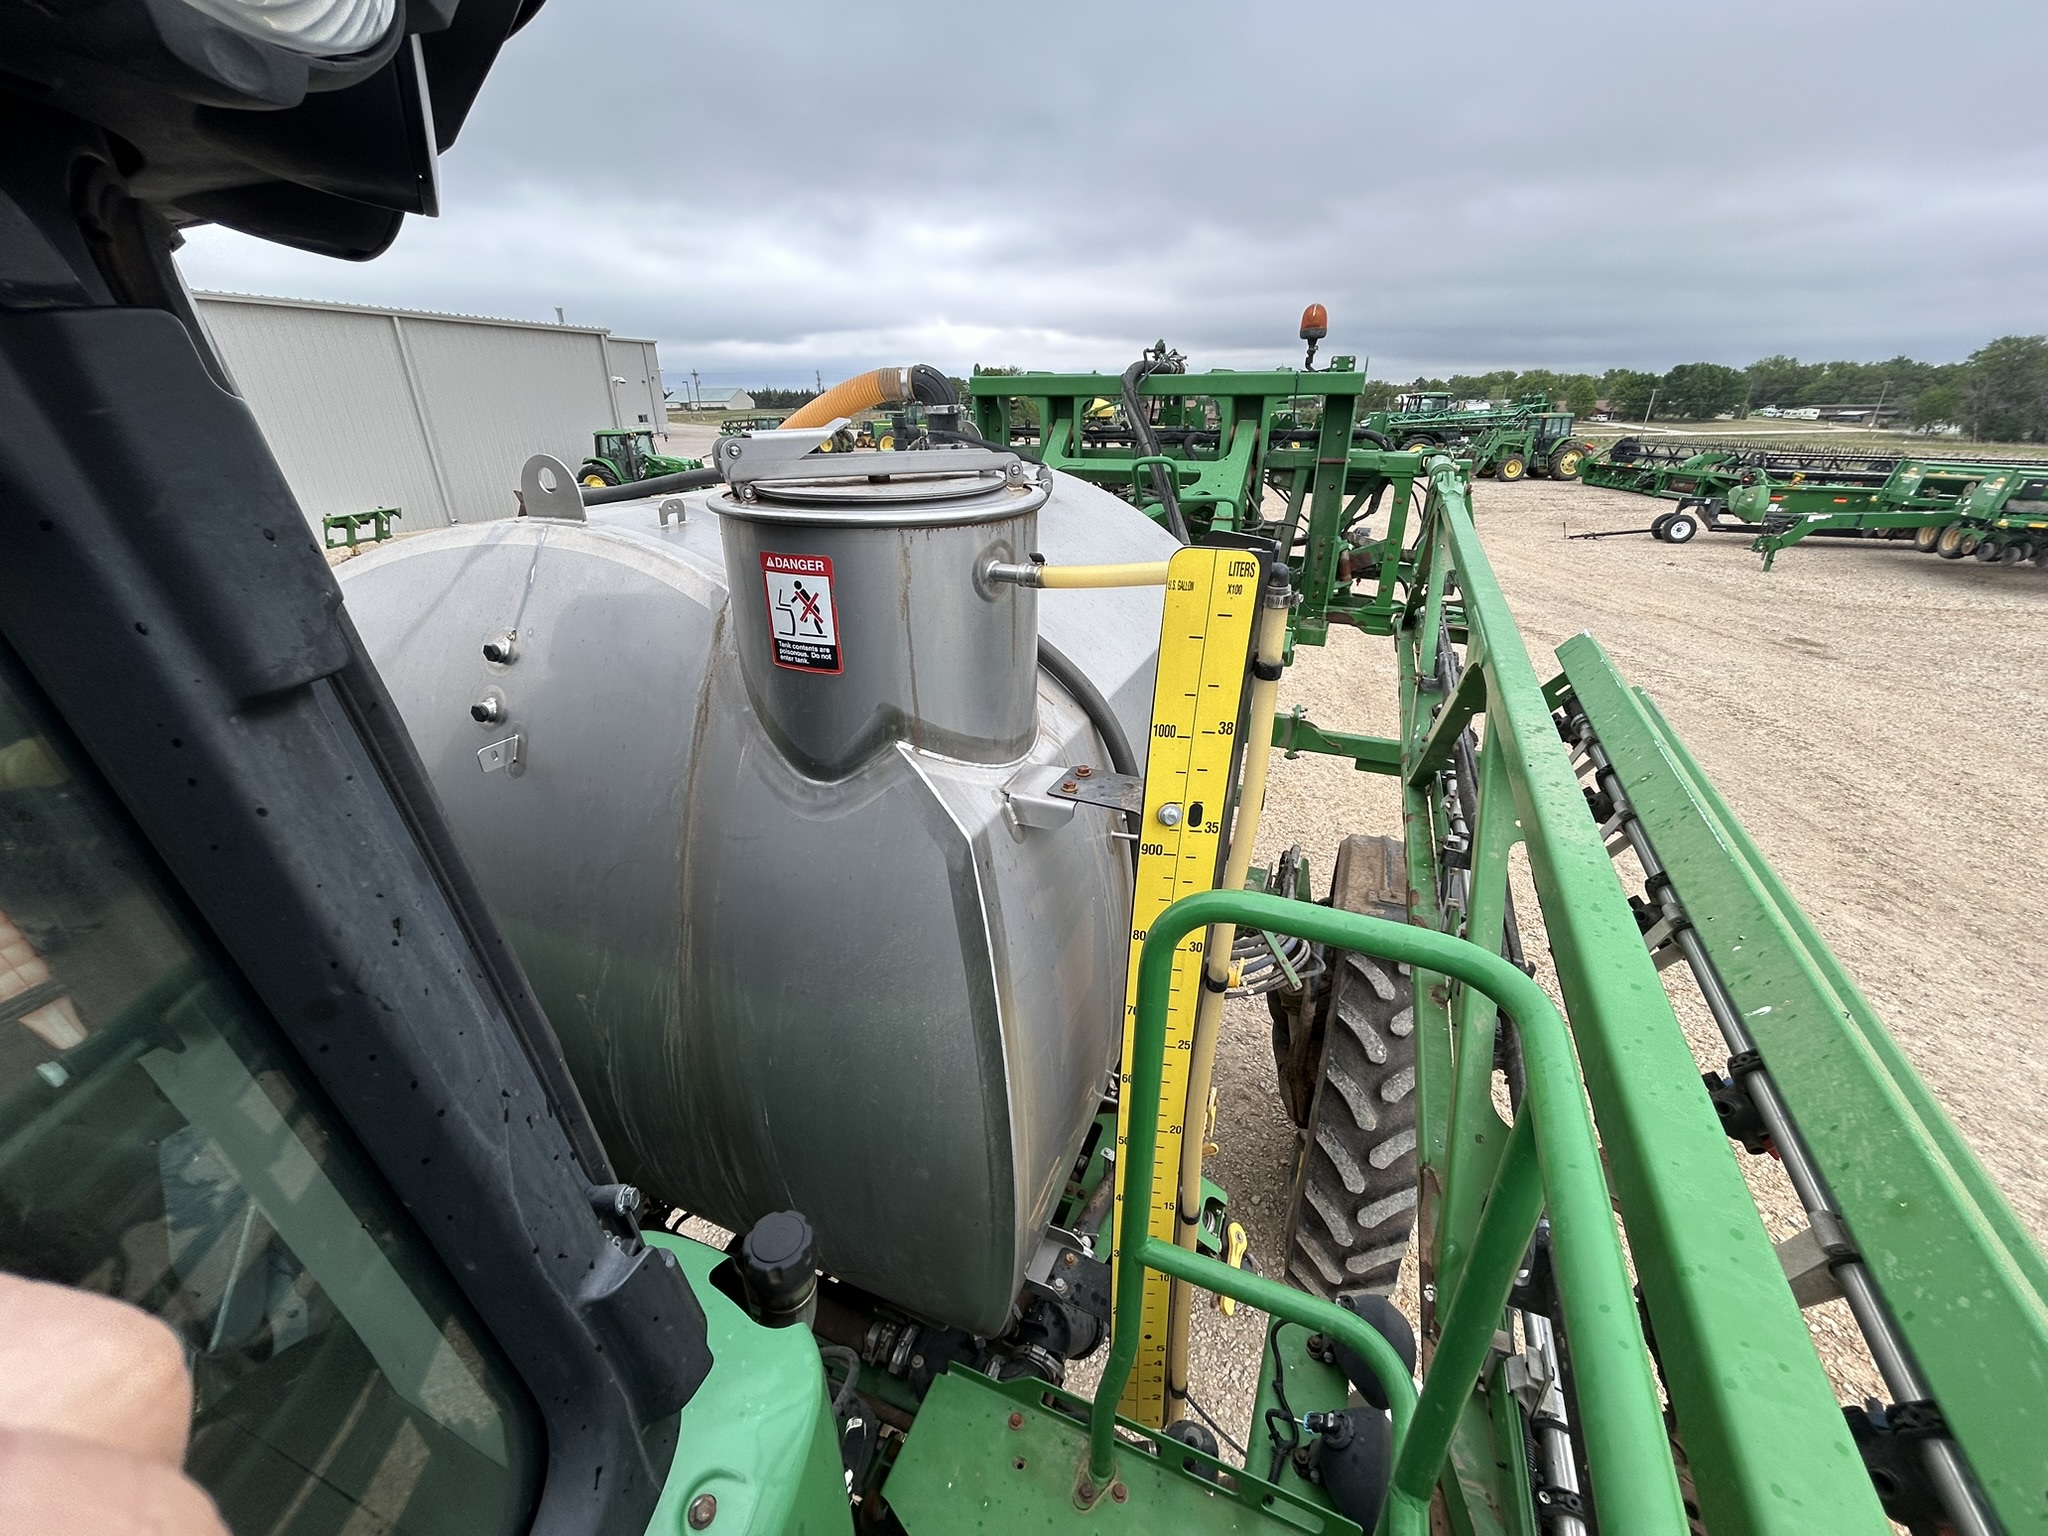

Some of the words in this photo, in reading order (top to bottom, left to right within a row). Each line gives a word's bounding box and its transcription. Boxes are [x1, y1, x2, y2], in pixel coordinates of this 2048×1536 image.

[775, 557, 824, 571] DANGER
[1228, 561, 1256, 578] LITERS
[1226, 583, 1243, 595] X100
[778, 640, 791, 649] Tank
[792, 643, 818, 653] contents
[780, 648, 809, 658] poisonous.
[811, 651, 820, 659] Do
[780, 654, 794, 662] enter
[1153, 724, 1176, 738] 1000
[1217, 721, 1234, 735] 38
[1204, 821, 1219, 834] 35
[1141, 843, 1163, 856] 900
[1189, 941, 1203, 953] 30
[1177, 1039, 1190, 1050] 25
[1169, 1125, 1182, 1135] 20
[1164, 1202, 1175, 1210] 15
[1159, 1274, 1170, 1282] 10
